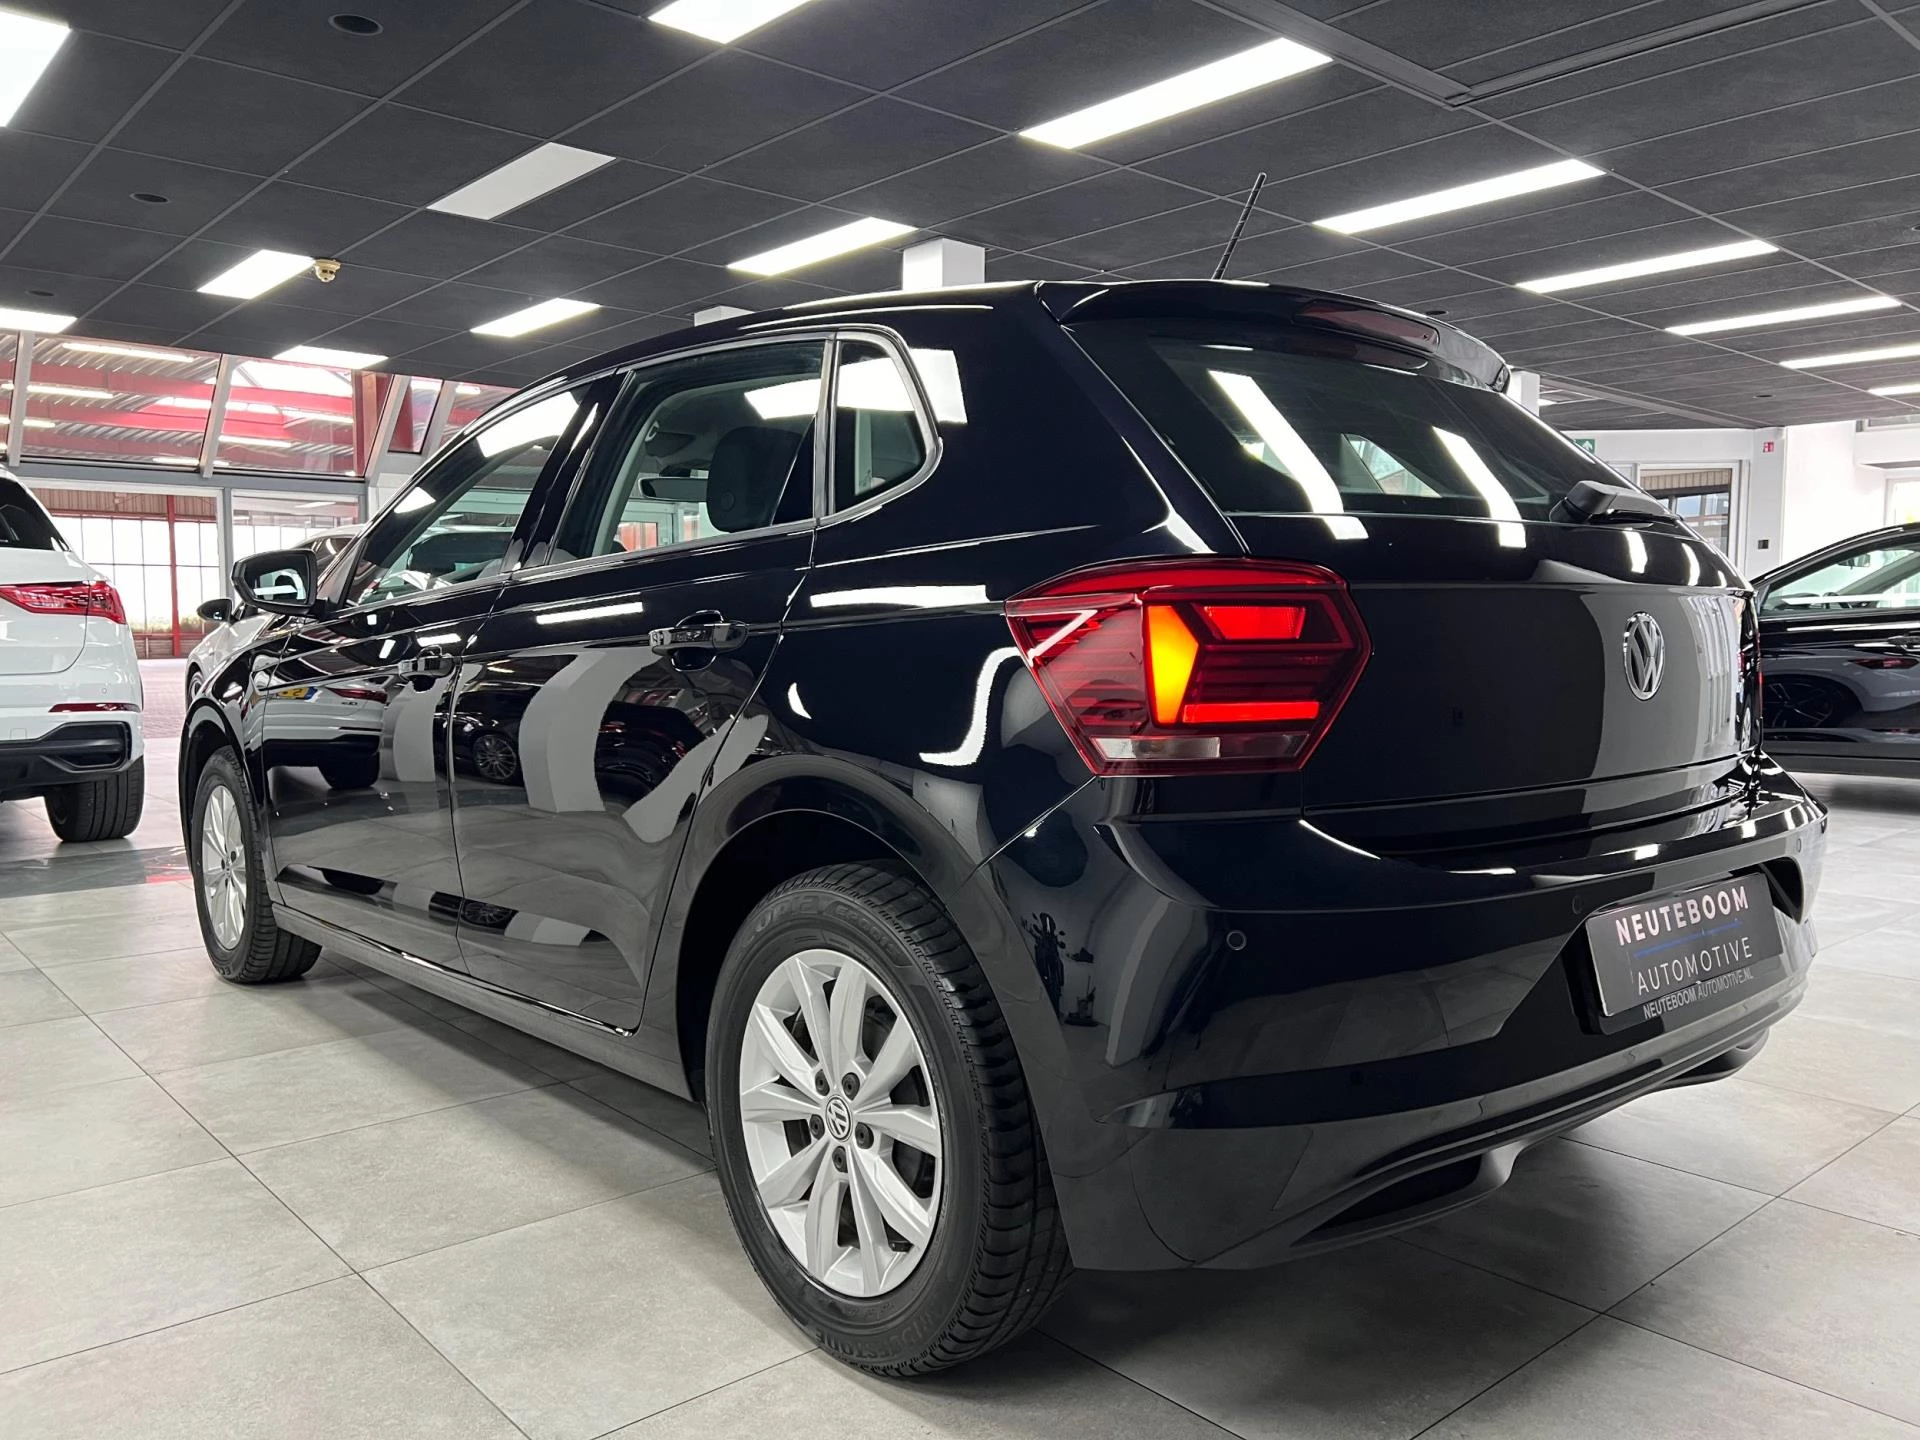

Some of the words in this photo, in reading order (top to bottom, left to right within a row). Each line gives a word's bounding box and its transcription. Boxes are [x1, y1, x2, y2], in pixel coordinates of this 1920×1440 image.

[1615, 886, 1749, 945] NEUTEBOOM
[1637, 937, 1753, 995] AUTOMOTIVE
[1643, 987, 1697, 1020] NEUTEBOOM
